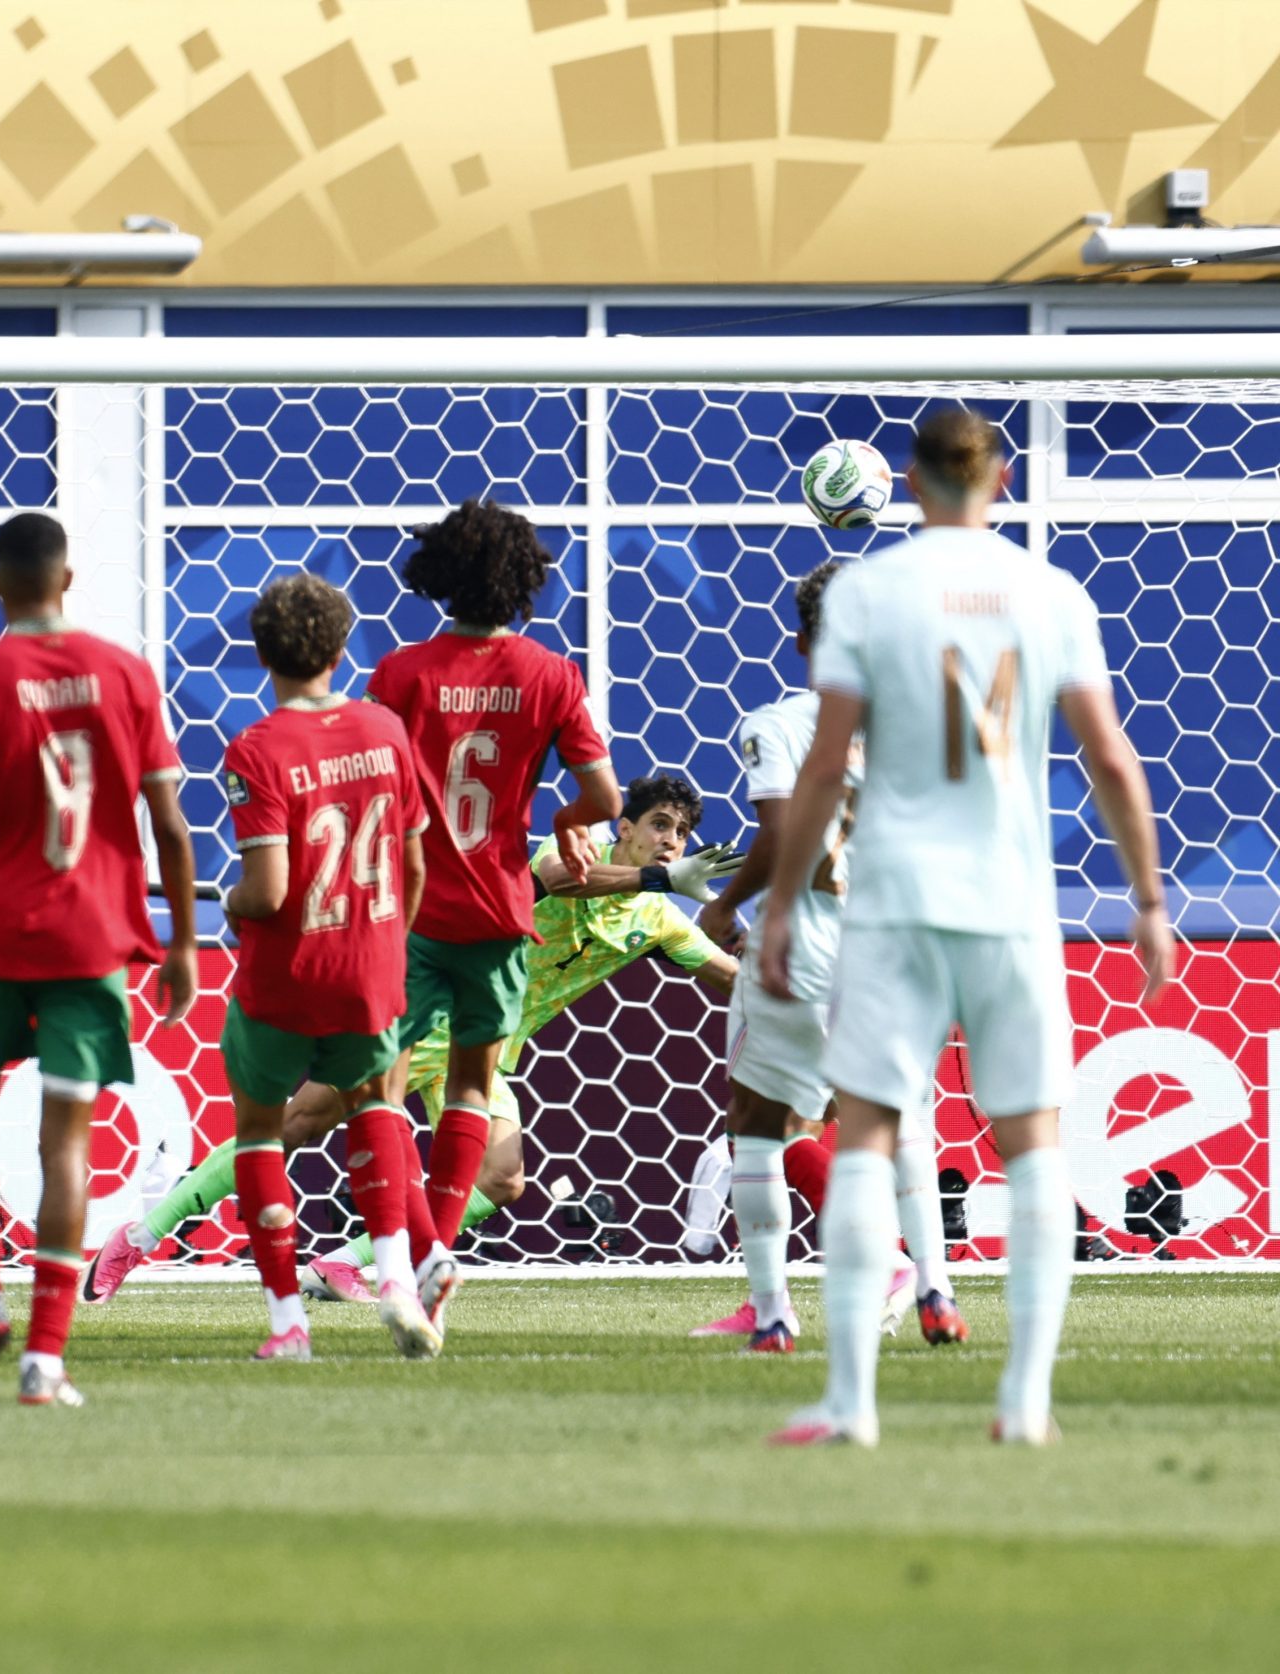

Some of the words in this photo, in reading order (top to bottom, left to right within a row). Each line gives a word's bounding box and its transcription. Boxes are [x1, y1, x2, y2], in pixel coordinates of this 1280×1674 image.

[439, 685, 522, 714] BOUADDI
[289, 764, 318, 795] EL
[318, 745, 396, 788] AYNAOUI
[445, 730, 500, 856] 6
[302, 792, 400, 936] 24
